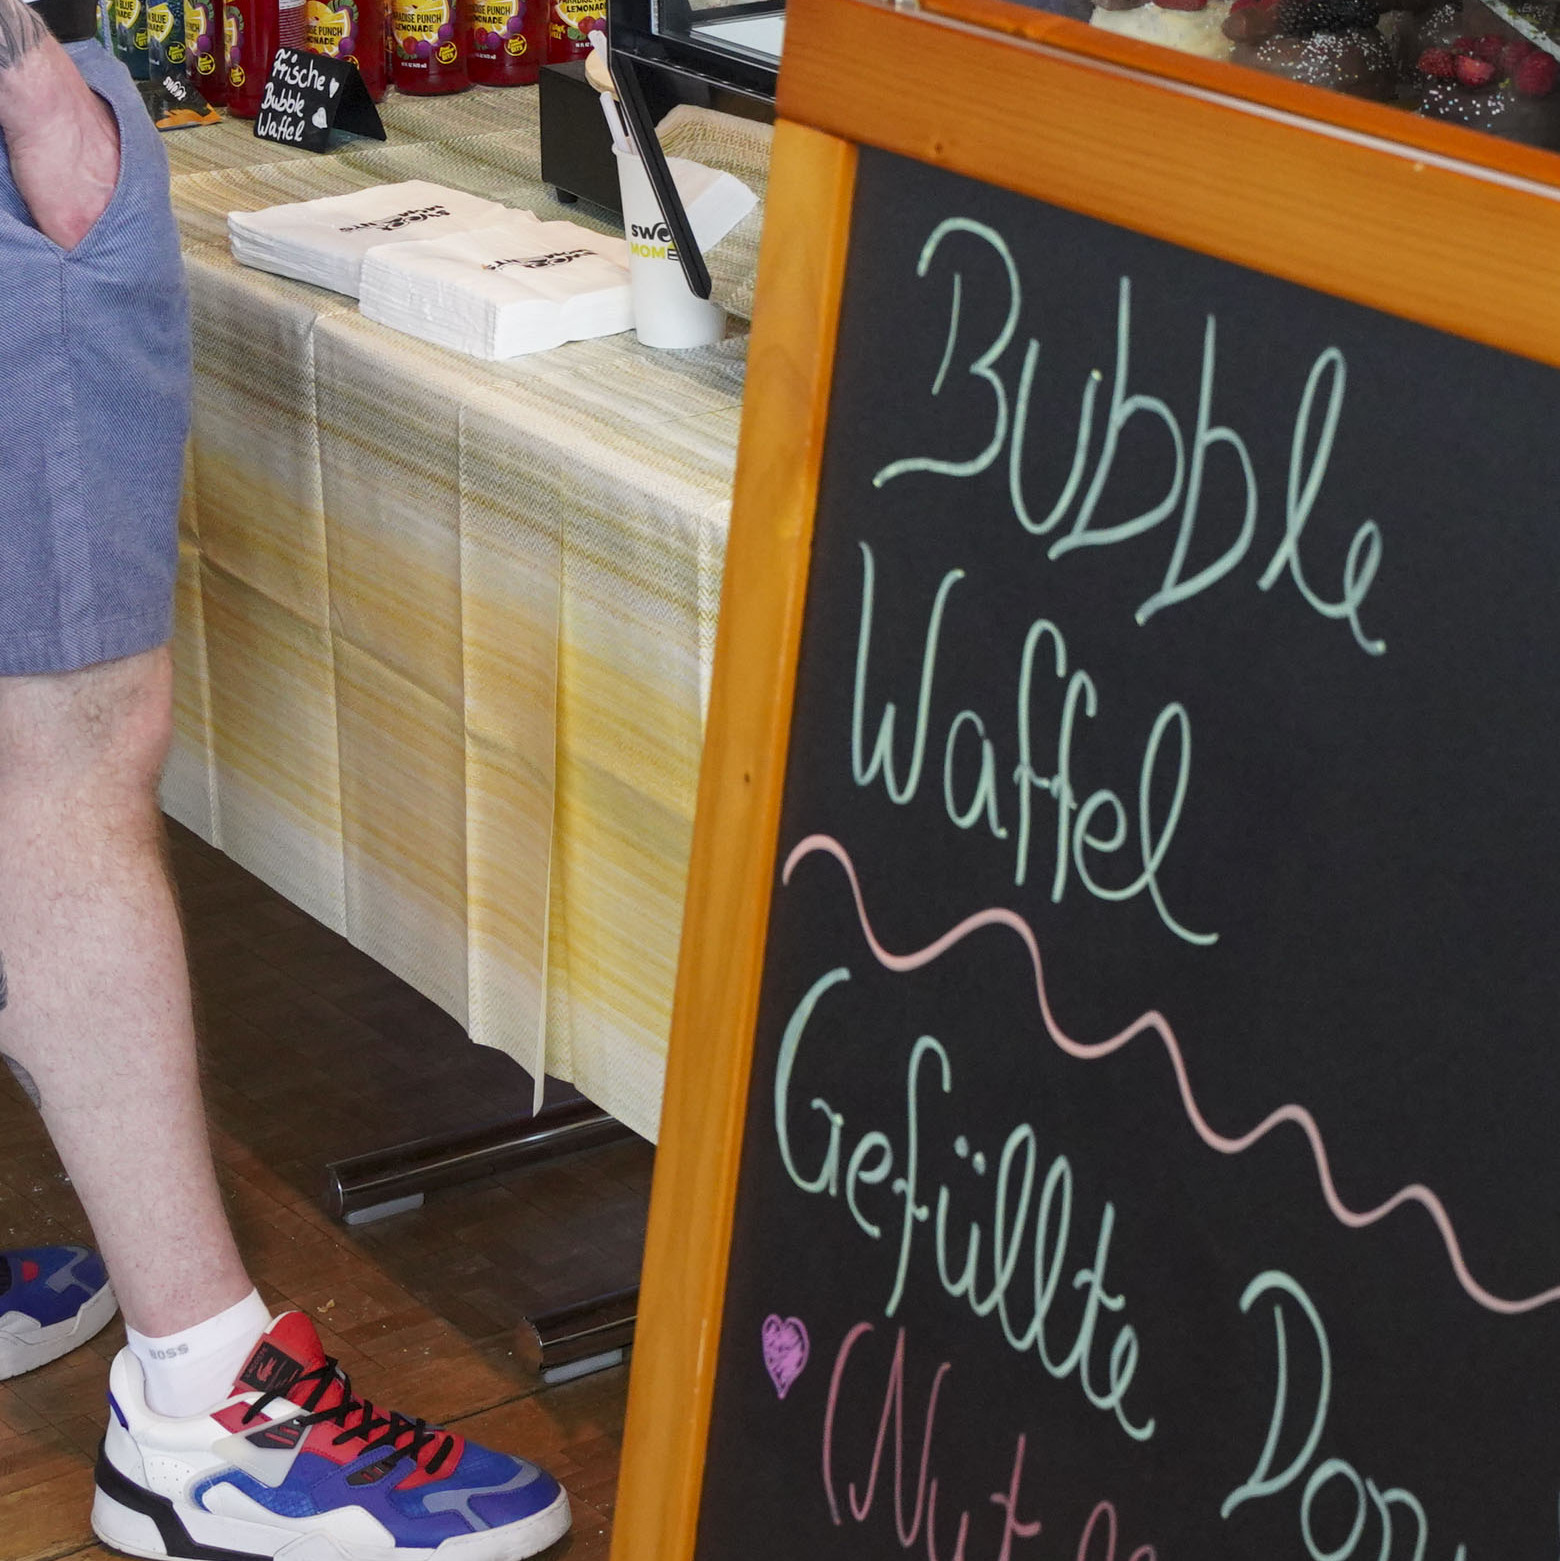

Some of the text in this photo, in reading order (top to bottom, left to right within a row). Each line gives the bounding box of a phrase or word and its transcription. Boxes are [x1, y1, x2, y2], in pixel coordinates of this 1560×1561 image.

[416, 12, 442, 23] PUNCH
[272, 48, 325, 91] Frische
[262, 82, 305, 117] Bubble
[257, 113, 305, 141] Waffel
[631, 222, 673, 243] swe
[873, 217, 1386, 654] Bubble
[851, 542, 1220, 945] Waffel
[773, 967, 1155, 1442] Gefüllte
